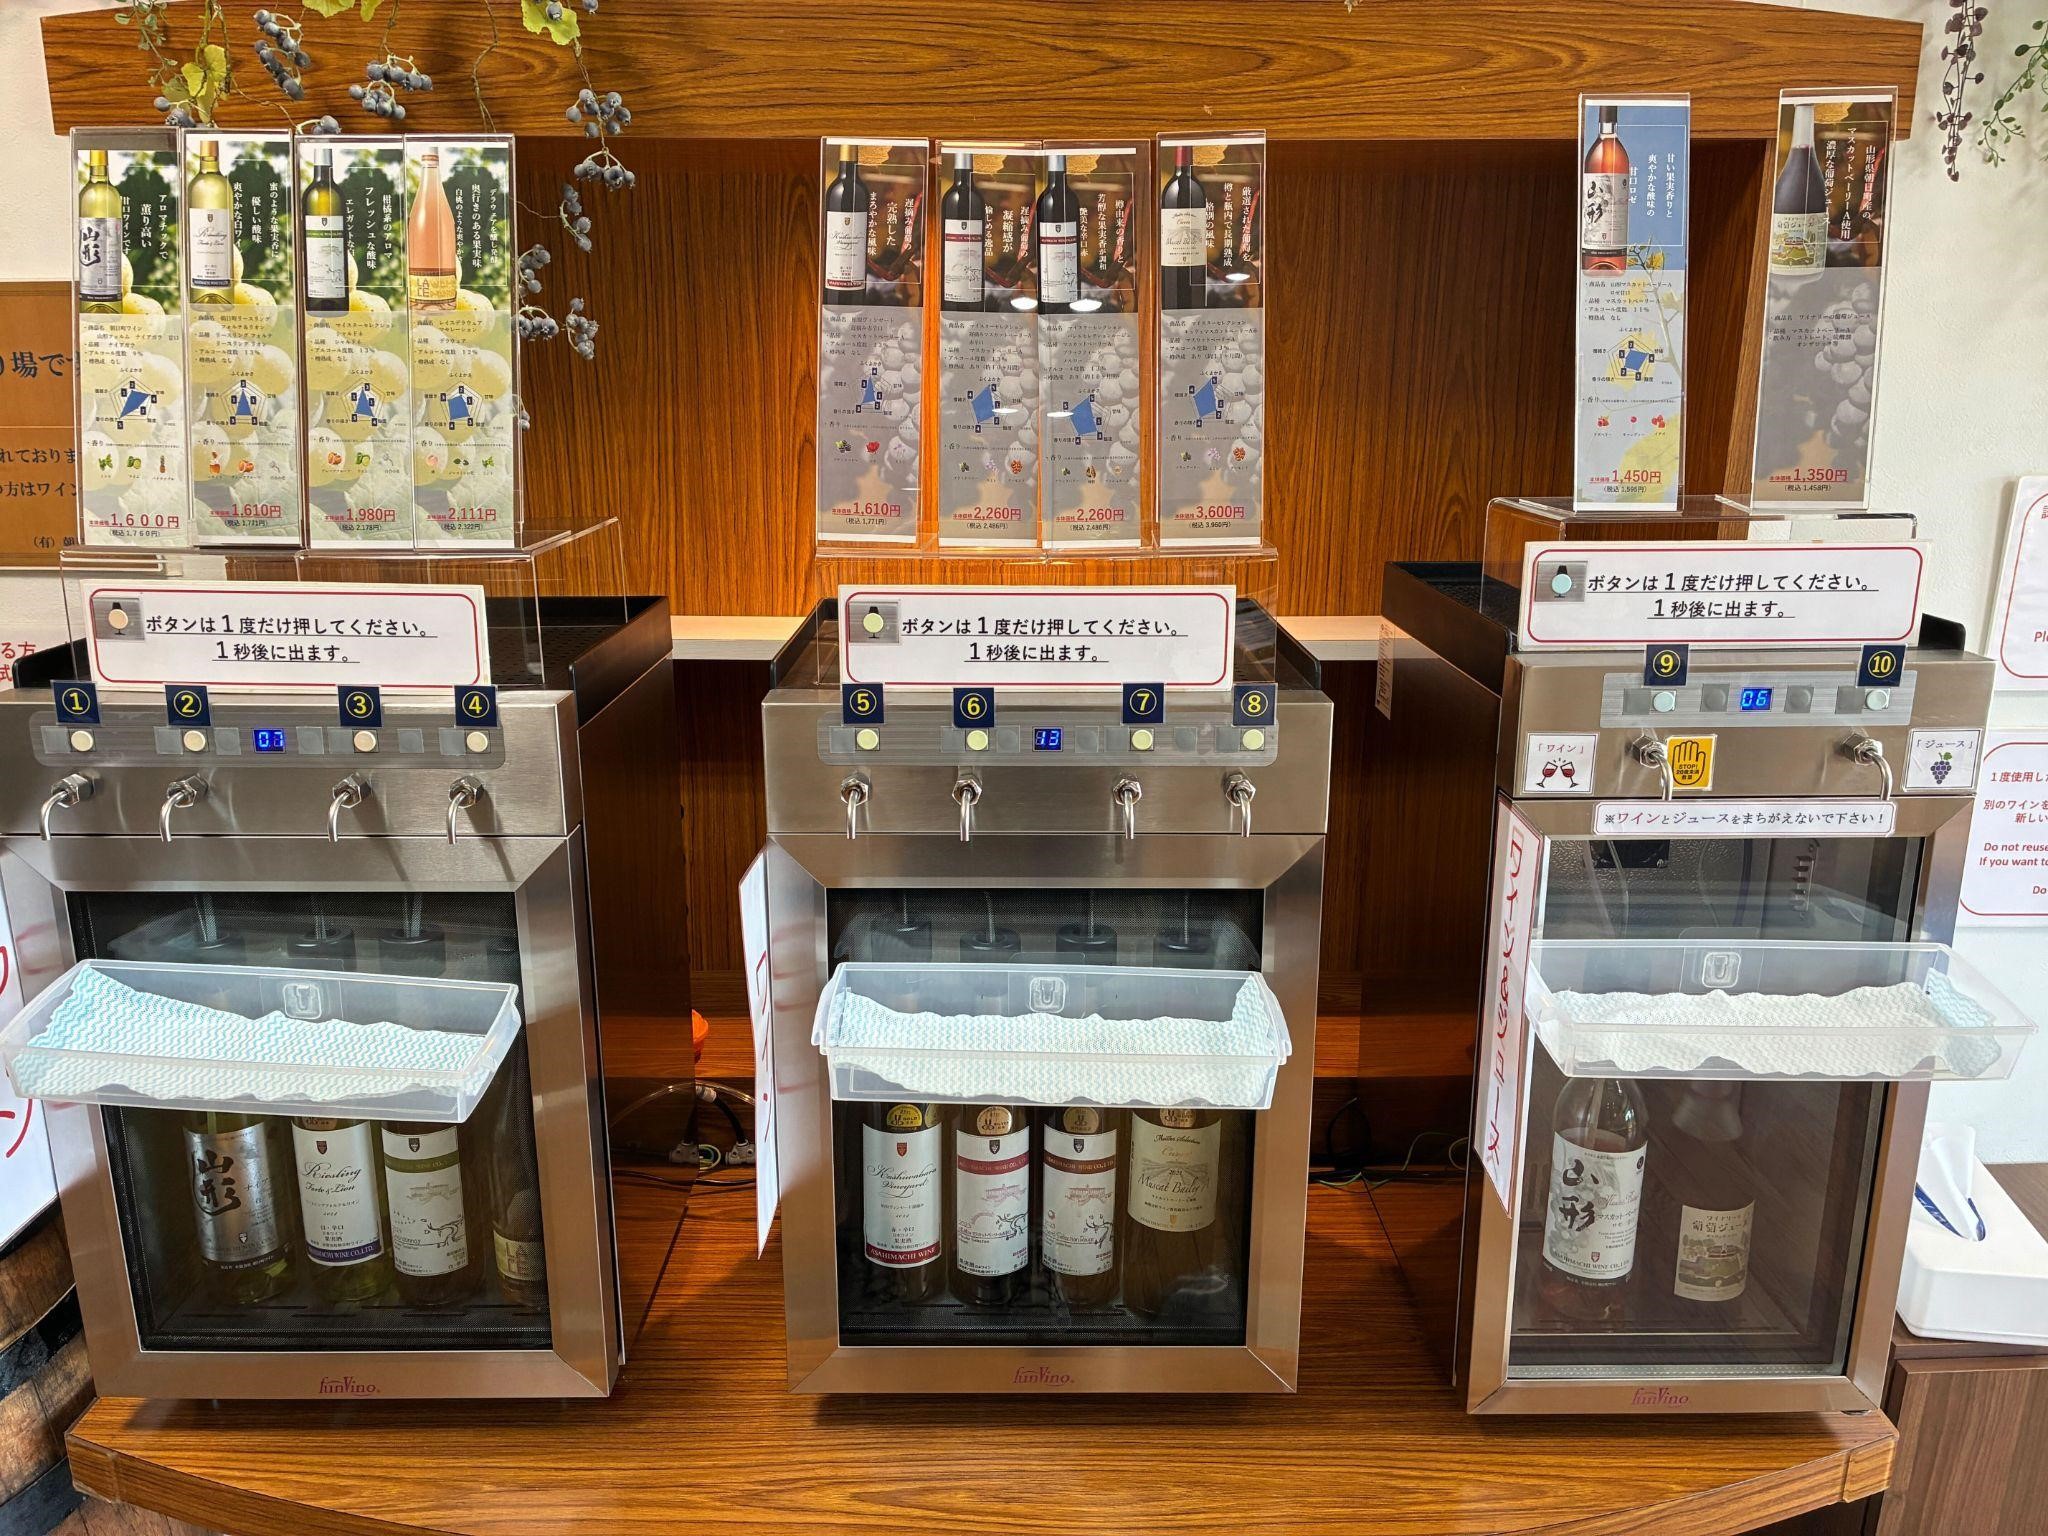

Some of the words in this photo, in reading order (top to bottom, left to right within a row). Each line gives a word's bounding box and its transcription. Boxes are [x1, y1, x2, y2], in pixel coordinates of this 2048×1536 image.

[1629, 167, 1638, 203] 甘口ロゼ
[1647, 154, 1656, 216] 爽やかな酸味の
[1666, 154, 1675, 218] 甘い果実香りと
[1823, 141, 1836, 224] 濃厚な葡萄ジュース
[1862, 145, 1876, 219] 山形県朝日町産の
[141, 204, 152, 248] 薫り高い
[159, 195, 167, 260] アロマチックで
[252, 196, 262, 243] 優しい酸味
[270, 182, 279, 258] 蜜のような果実香に
[366, 188, 376, 269] フレッシュな酸味
[383, 195, 392, 258] 柑橘系のアロマ
[472, 184, 482, 268] 奥行きのある果実味
[867, 192, 877, 256] まろやかな風味
[887, 202, 897, 246] 完熟した
[1206, 201, 1215, 248] 格別の風味
[1224, 183, 1232, 267] 樽と瓶内で長期熟成
[1242, 187, 1251, 261] 厳選された葡萄を
[1003, 210, 1014, 253] 凝縮感が
[1612, 470, 1661, 483] 1,450円
[1793, 469, 1848, 482] 1,350円
[232, 504, 281, 517] 1,610円
[346, 508, 396, 522] 1,980円
[448, 507, 496, 521] 2,111円
[853, 502, 900, 516] 1,610円
[974, 506, 1021, 520] 2,260円
[1076, 508, 1124, 522] 2,260円
[1196, 505, 1245, 519] 3,600円
[1588, 571, 1871, 593] ボタンは1度だけ押してください。
[1653, 600, 1786, 619] 1秒後に出ます。
[146, 612, 428, 637] ボタンは1度だけ押してください。
[902, 616, 1178, 636] ボタンは1度だけ押してください。
[216, 640, 352, 663] 1秒後に出ます。
[969, 642, 1100, 662] 1秒後に出ます。
[1741, 688, 1767, 708] 06
[1035, 730, 1060, 747] 13
[1984, 842, 1998, 852] Do
[2001, 843, 2020, 852] not
[1979, 856, 1987, 866] If
[1990, 859, 2009, 868] you
[2012, 857, 2038, 866] want
[2032, 885, 2047, 894] Do
[302, 1161, 362, 1184] Riesling
[1138, 1173, 1169, 1192] Muscat
